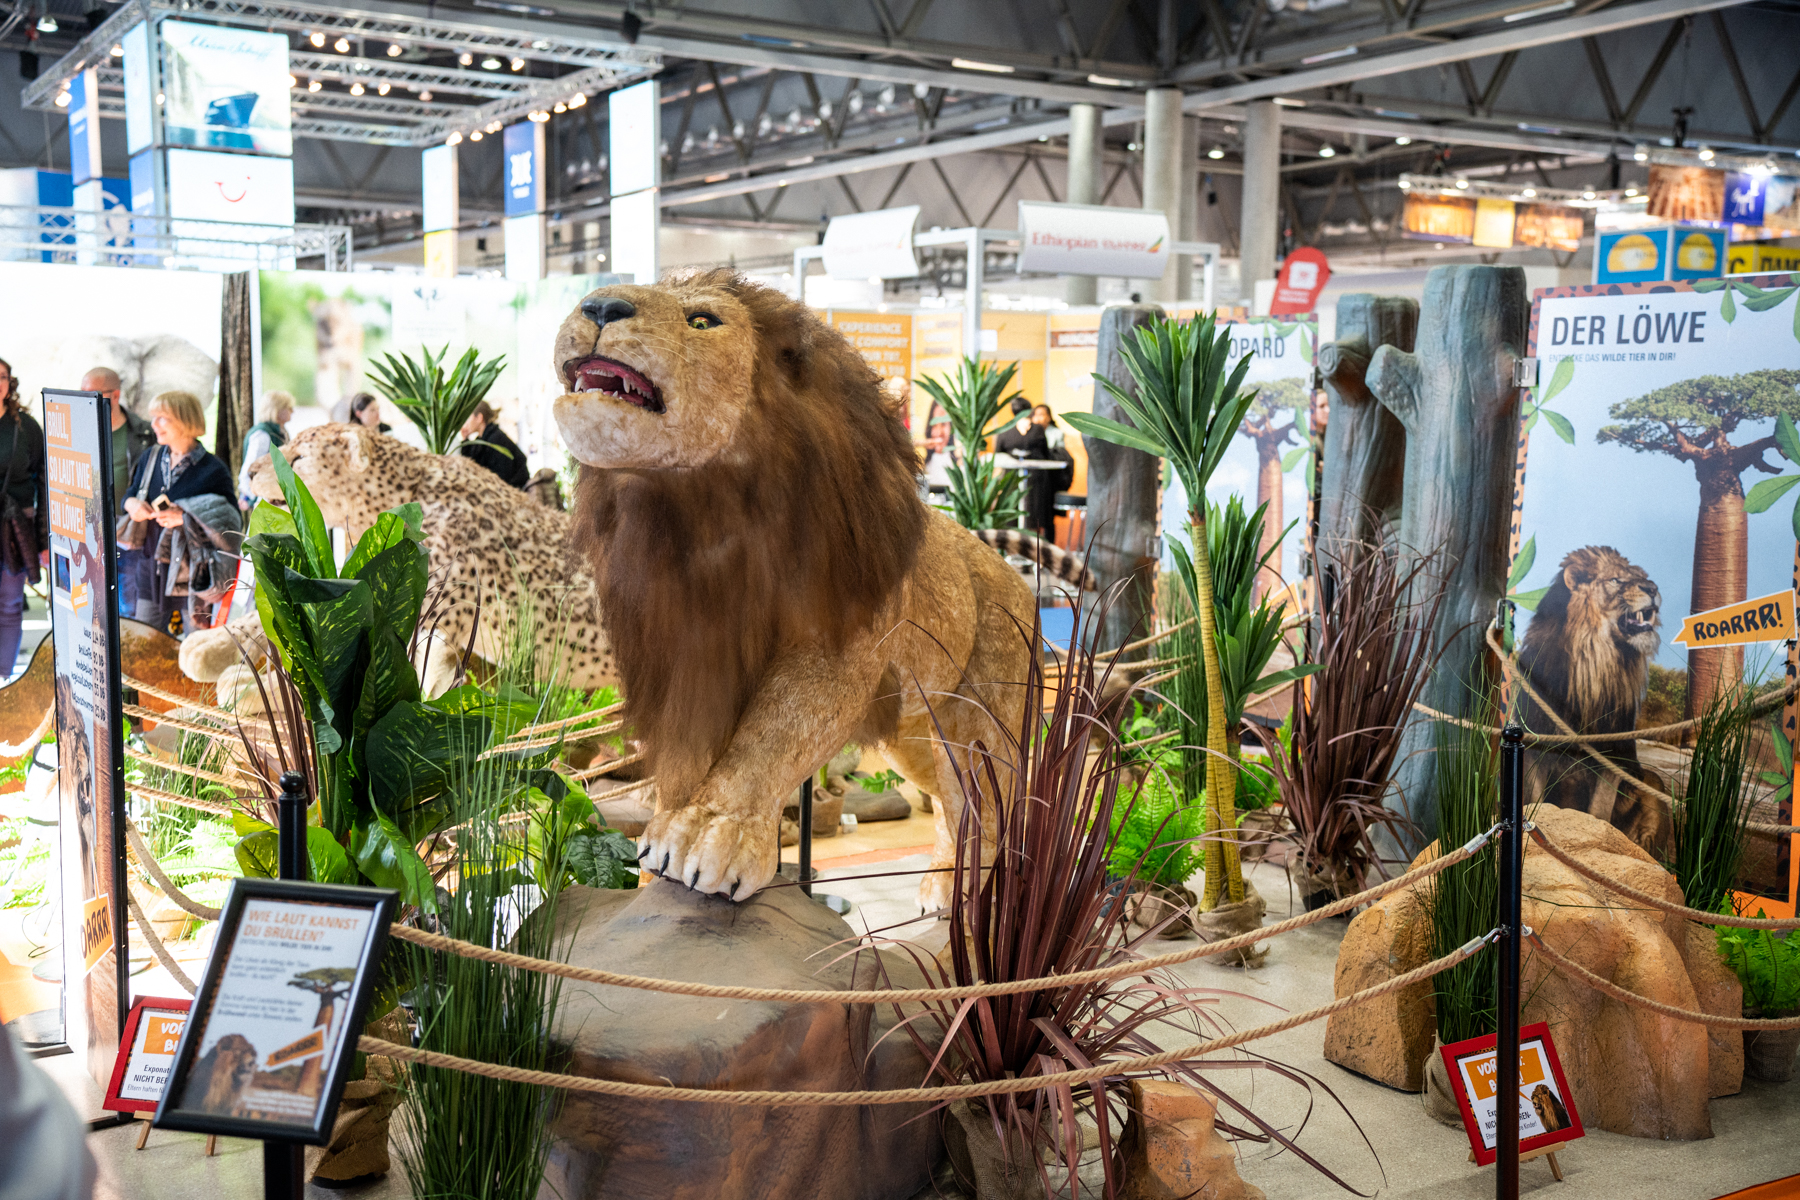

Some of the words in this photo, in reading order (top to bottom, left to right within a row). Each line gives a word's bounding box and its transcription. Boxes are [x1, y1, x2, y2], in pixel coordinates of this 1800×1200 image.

[1551, 314, 1606, 346] DER
[1616, 304, 1707, 344] LÖWE
[1229, 337, 1286, 359] OPARD
[1585, 353, 1600, 362] DAS
[1601, 353, 1626, 362] WILDE
[1629, 352, 1646, 361] TIER
[1648, 352, 1657, 361] IN
[1659, 352, 1676, 361] DIR!
[47, 405, 69, 442] BRÜLL,
[49, 455, 59, 481] SO
[58, 457, 75, 487] LAUT
[75, 461, 91, 491] WIE
[51, 499, 61, 527] EIN
[61, 497, 84, 535] LÖWE!
[1693, 602, 1784, 641] ROARRR!
[243, 924, 262, 936] DU
[248, 910, 272, 922] WIE
[274, 912, 306, 926] LAUT
[309, 916, 360, 930] KANNST
[80, 904, 112, 959] OARRR!
[133, 1074, 155, 1083] NICHT
[143, 1064, 172, 1075] Exponat
[127, 1084, 141, 1092] Eltern
[1523, 1121, 1538, 1131] Kinder!
